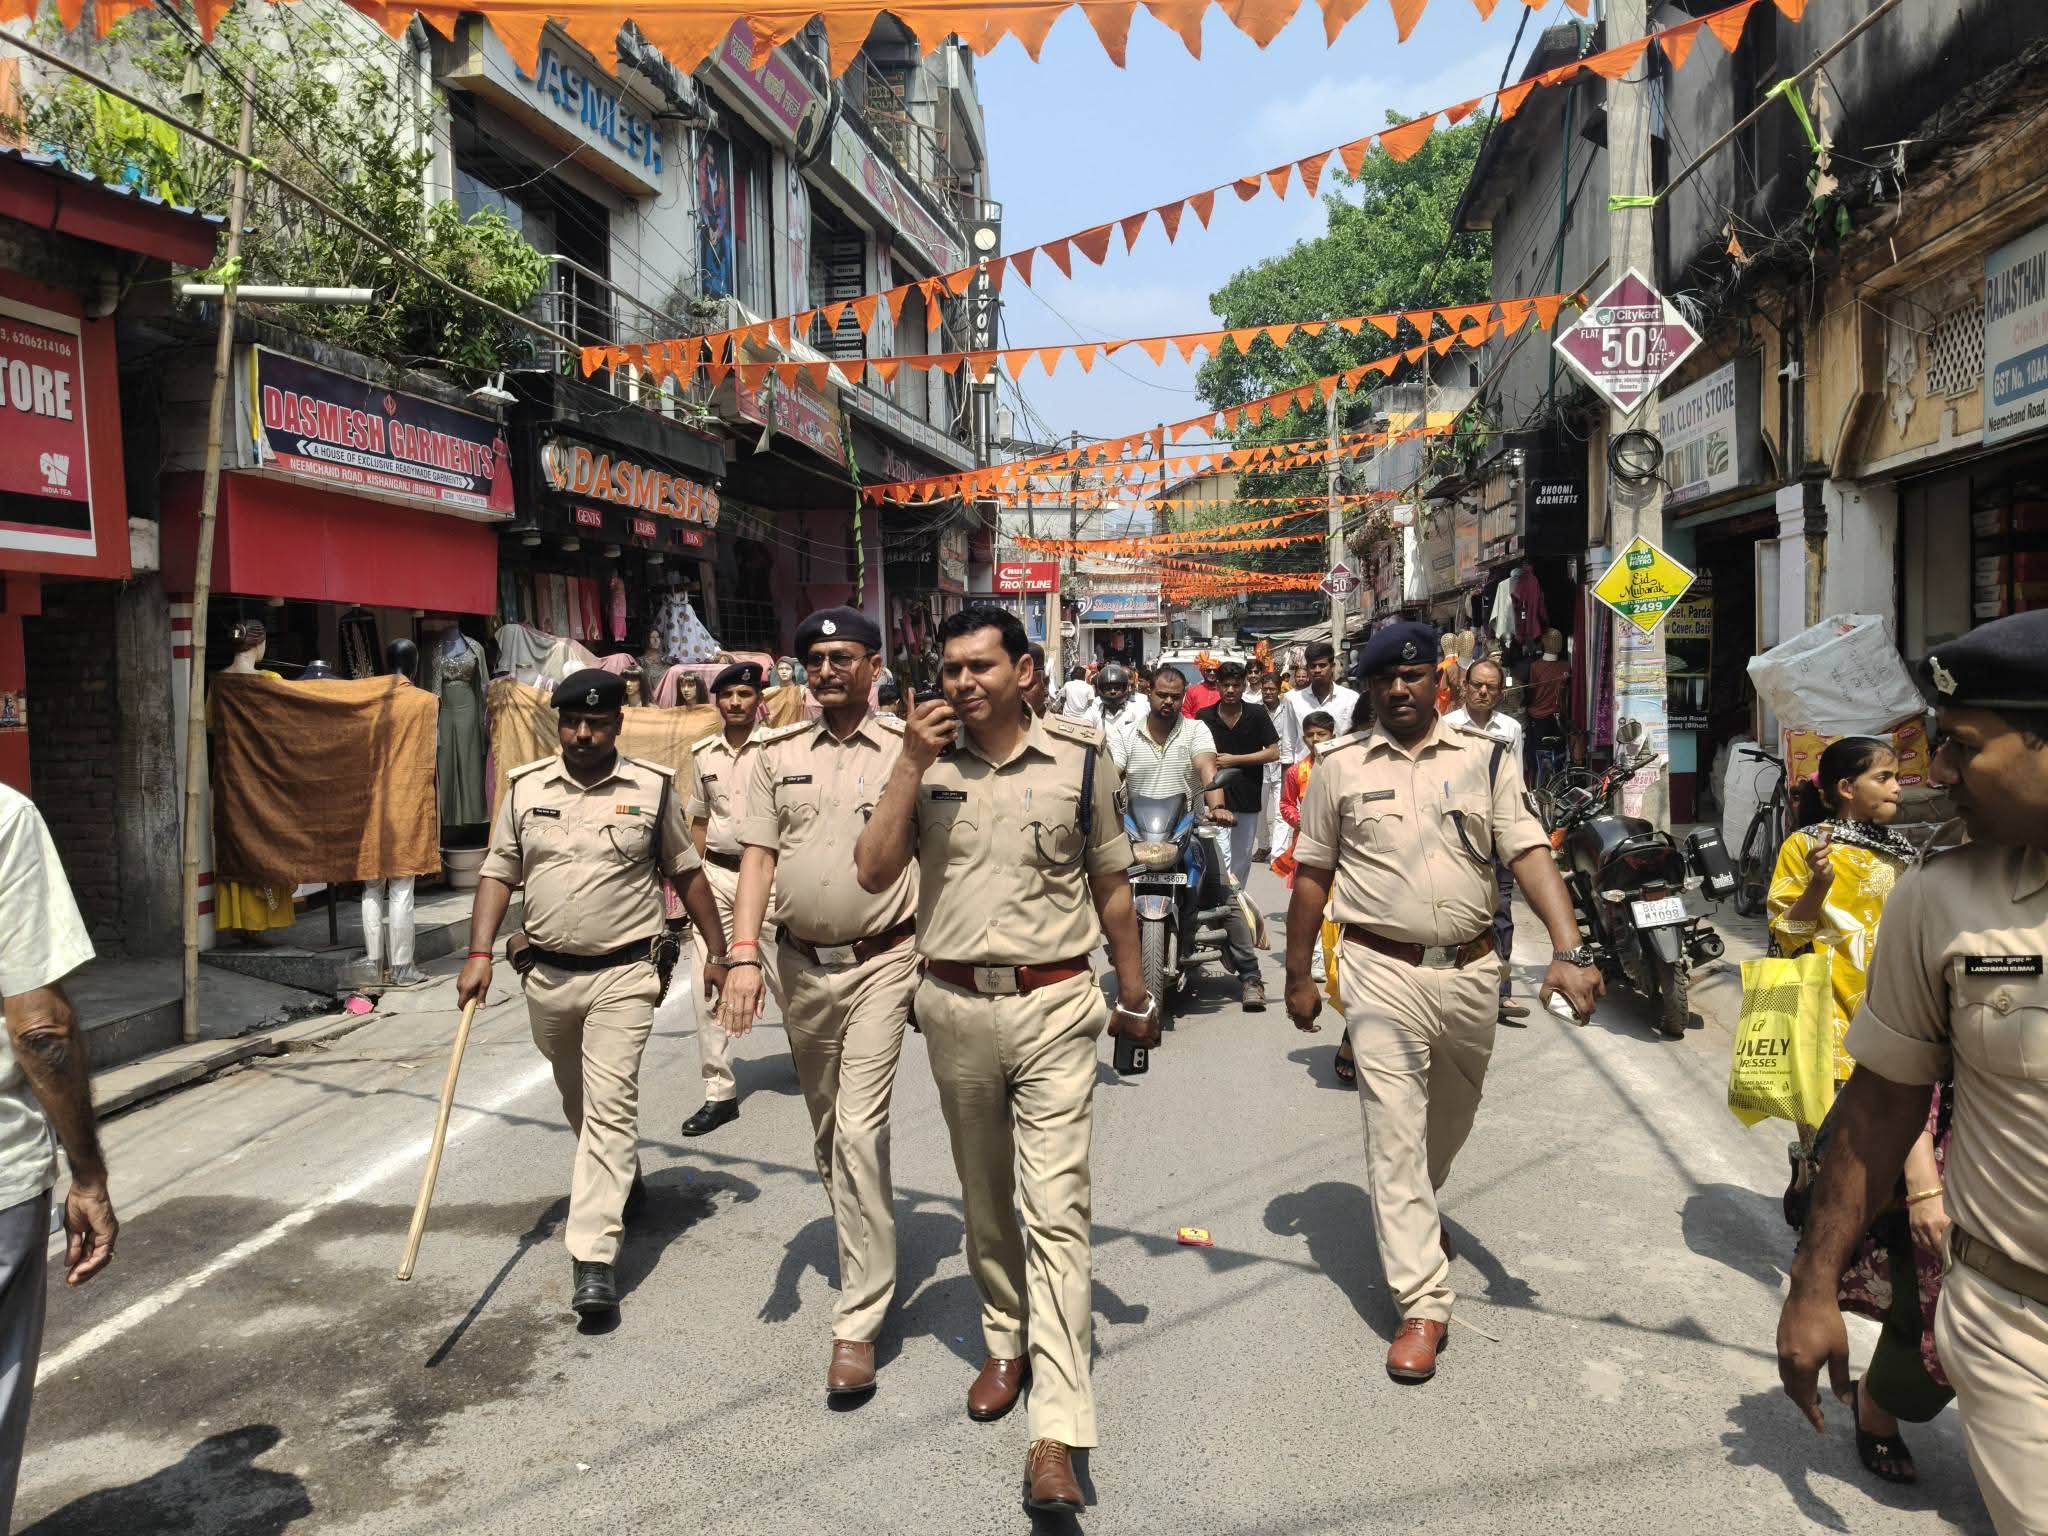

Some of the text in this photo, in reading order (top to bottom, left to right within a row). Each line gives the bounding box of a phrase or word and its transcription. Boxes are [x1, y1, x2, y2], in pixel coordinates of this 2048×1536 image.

[514, 47, 664, 175] ASMESH
[1986, 250, 2047, 324] RAJASTHAN
[1617, 308, 1660, 322] Citykart
[1580, 328, 1600, 339] FLAT
[12, 329, 72, 358] 6206214106
[1994, 368, 2010, 396] GST
[1677, 394, 1703, 432] CLOTH
[1705, 378, 1735, 419] STORE
[1988, 398, 2047, 433] Neemchand Road,
[263, 384, 496, 480] DASMESH GARMENTS
[289, 458, 341, 479] NEEMCHAND
[341, 468, 366, 484] ROAD,
[366, 474, 411, 493] KISHANGANJ
[313, 445, 463, 487] A HOUSE OF EXCLUSIVE READYMADE GARMENTS
[59, 487, 72, 497] TEA
[571, 446, 704, 524] DASMESH
[1540, 485, 1574, 495] BHOOMI
[1535, 494, 1579, 505] GARMENTS
[576, 508, 602, 527] GENTS
[999, 579, 1053, 591] FROTLINE
[1632, 571, 1657, 586] Eid
[1619, 581, 1669, 599] Mubarak
[1633, 601, 1663, 614] 2499
[1740, 1058, 1778, 1068] RESSES
